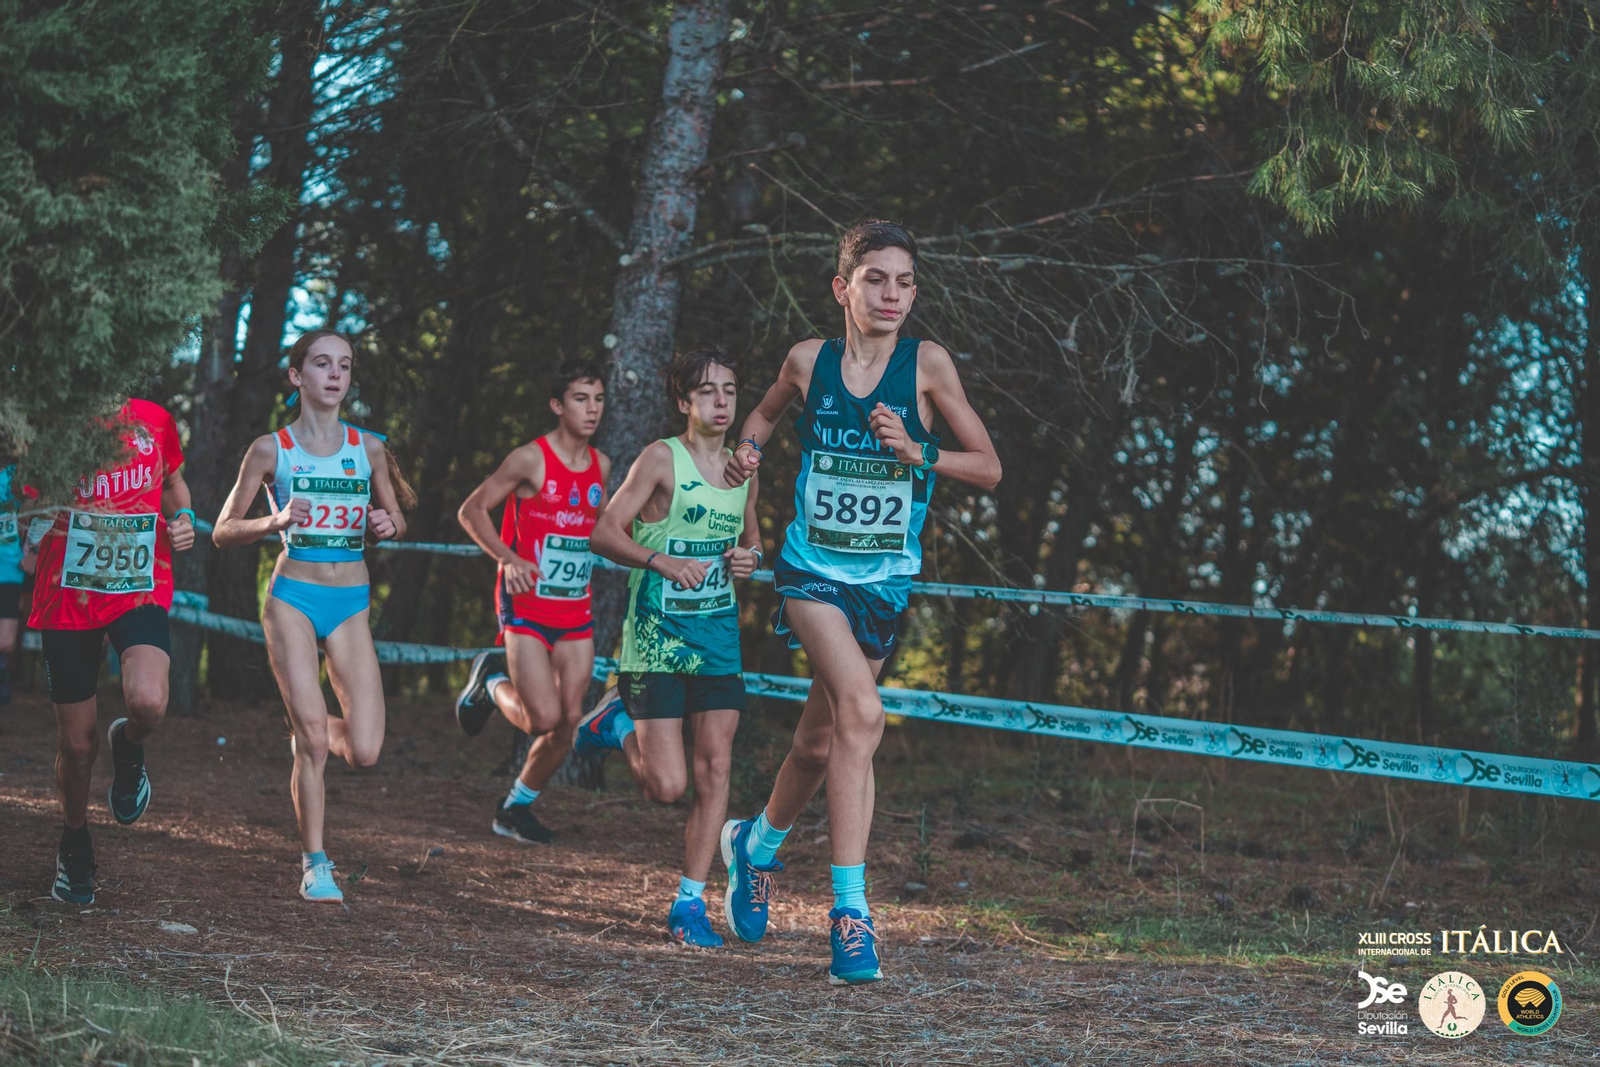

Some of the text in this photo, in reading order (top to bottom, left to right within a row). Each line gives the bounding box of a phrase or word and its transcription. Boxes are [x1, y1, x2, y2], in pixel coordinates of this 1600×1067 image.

[838, 459, 888, 475] ITÁLICA
[315, 478, 354, 489] ITÁLICA
[813, 489, 904, 526] 5892
[76, 541, 150, 571] 7950
[1161, 732, 1194, 747] Sevilla
[1269, 744, 1303, 760] Sevilla
[1382, 758, 1419, 774] Sevilla
[1503, 772, 1543, 788] Sevilla
